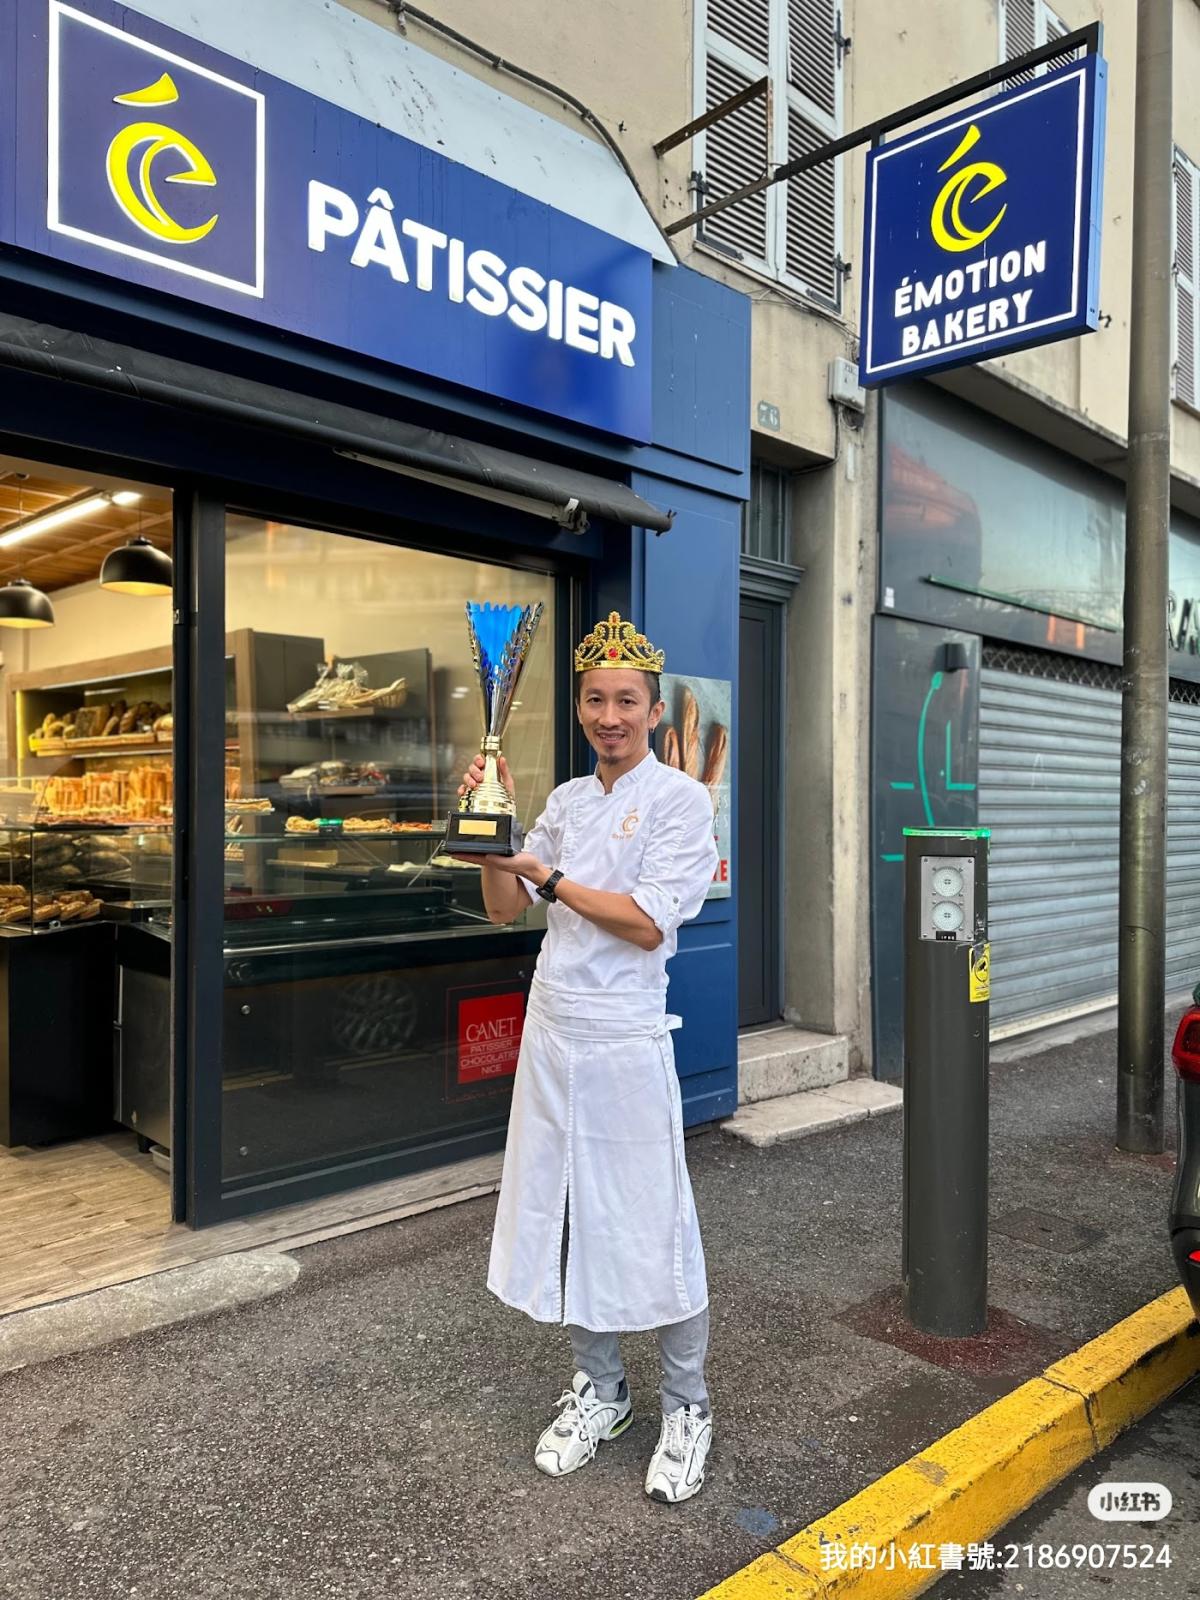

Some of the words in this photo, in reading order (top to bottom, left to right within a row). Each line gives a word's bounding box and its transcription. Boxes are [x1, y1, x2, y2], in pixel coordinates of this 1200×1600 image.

[307, 179, 636, 368] PÂTISSIER
[894, 240, 1047, 318] ÉMOTION
[902, 288, 1033, 357] BAKERY
[465, 1016, 517, 1042] CANET
[480, 1063, 503, 1076] NICE
